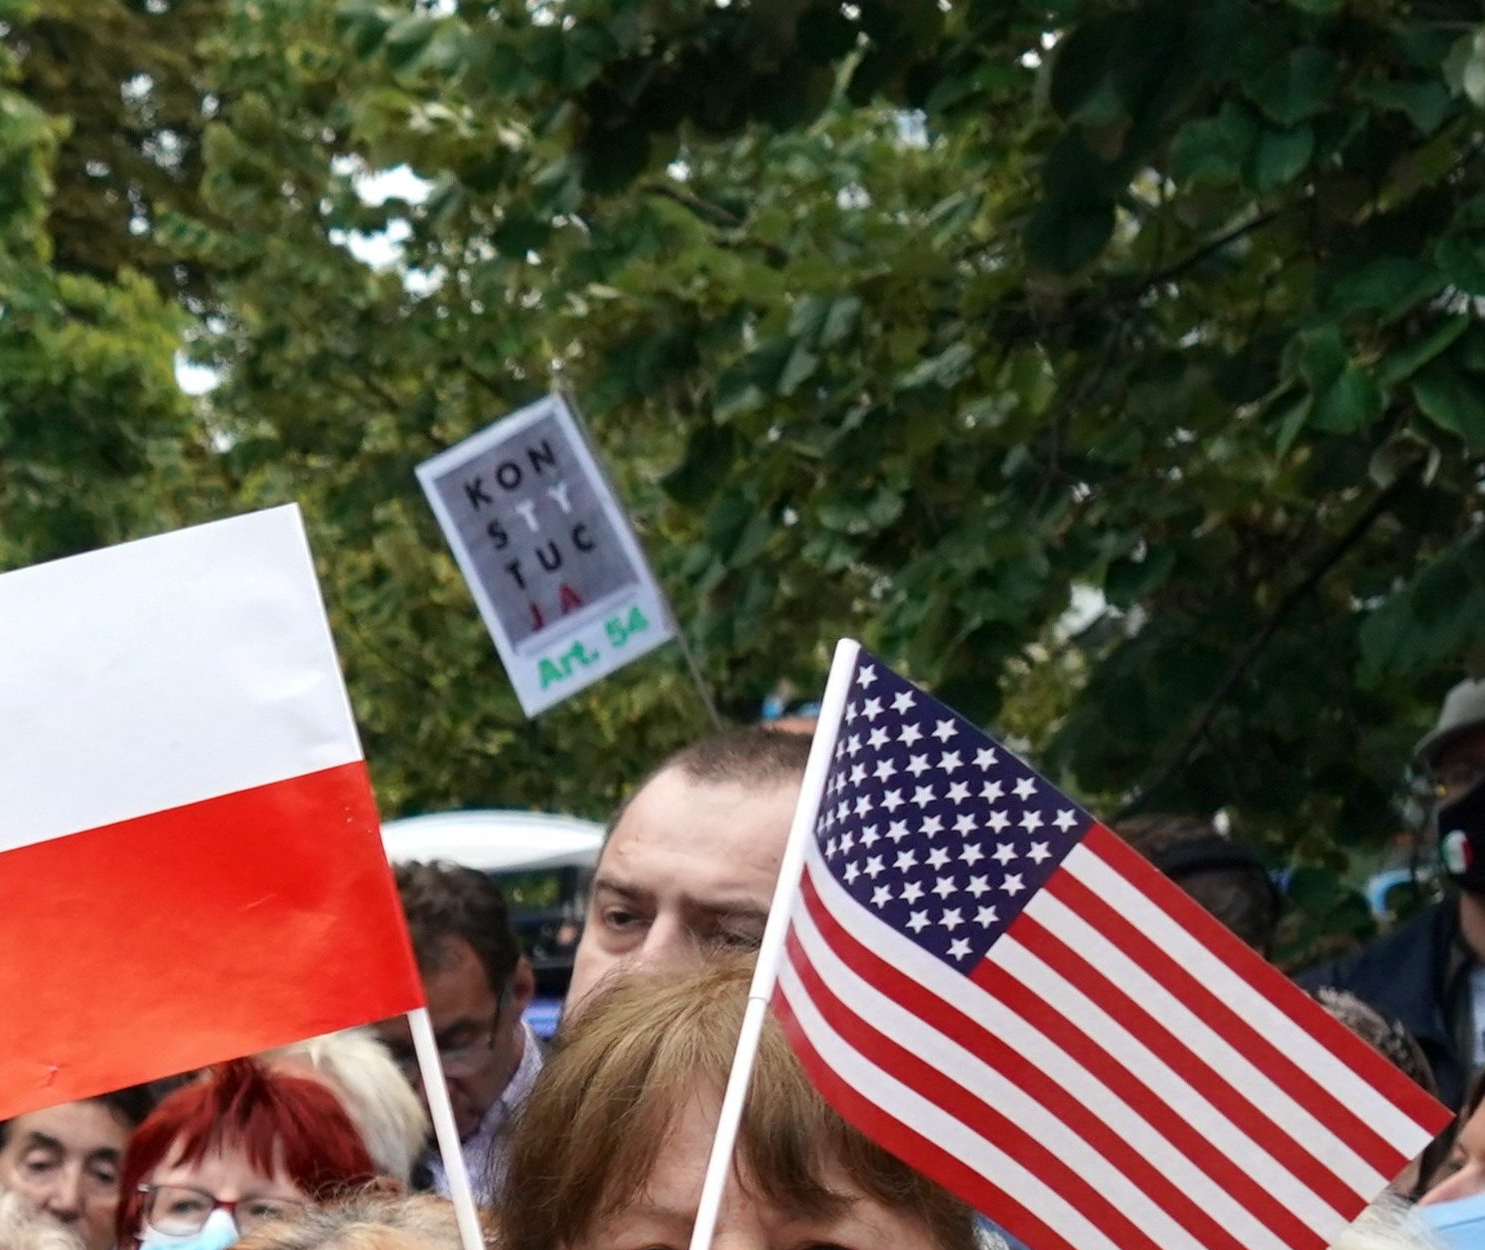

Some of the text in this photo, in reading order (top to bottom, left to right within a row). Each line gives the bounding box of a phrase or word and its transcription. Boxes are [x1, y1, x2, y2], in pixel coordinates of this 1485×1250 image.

[463, 437, 557, 510] KON
[485, 481, 572, 551] STY
[503, 522, 598, 590] TUC
[527, 582, 584, 633] JA
[537, 606, 649, 691] Art. 54
